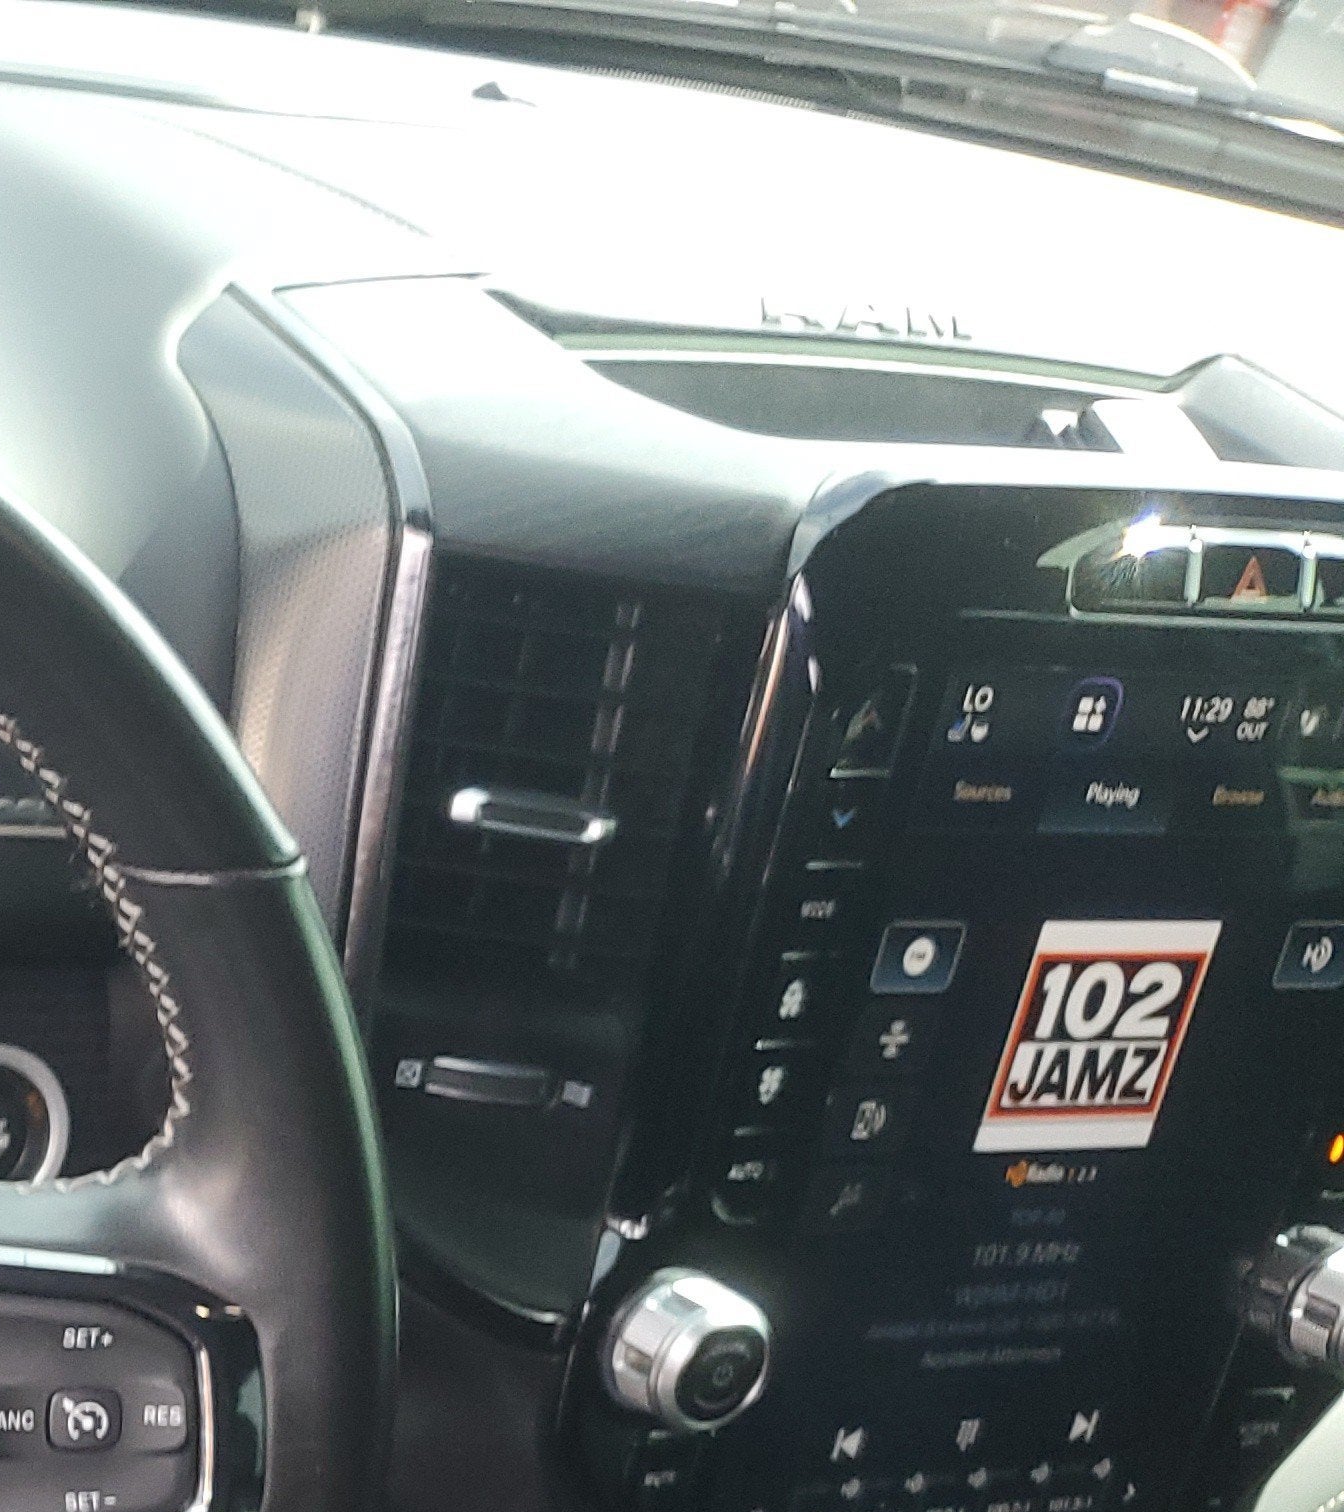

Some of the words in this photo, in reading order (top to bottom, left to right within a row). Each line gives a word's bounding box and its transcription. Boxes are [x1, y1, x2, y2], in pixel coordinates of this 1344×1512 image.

[1236, 721, 1270, 742] OUT
[1085, 781, 1141, 810] Playing
[1036, 960, 1184, 1041] 102
[1006, 1045, 1167, 1105] JAMZ
[143, 1404, 181, 1427] RES
